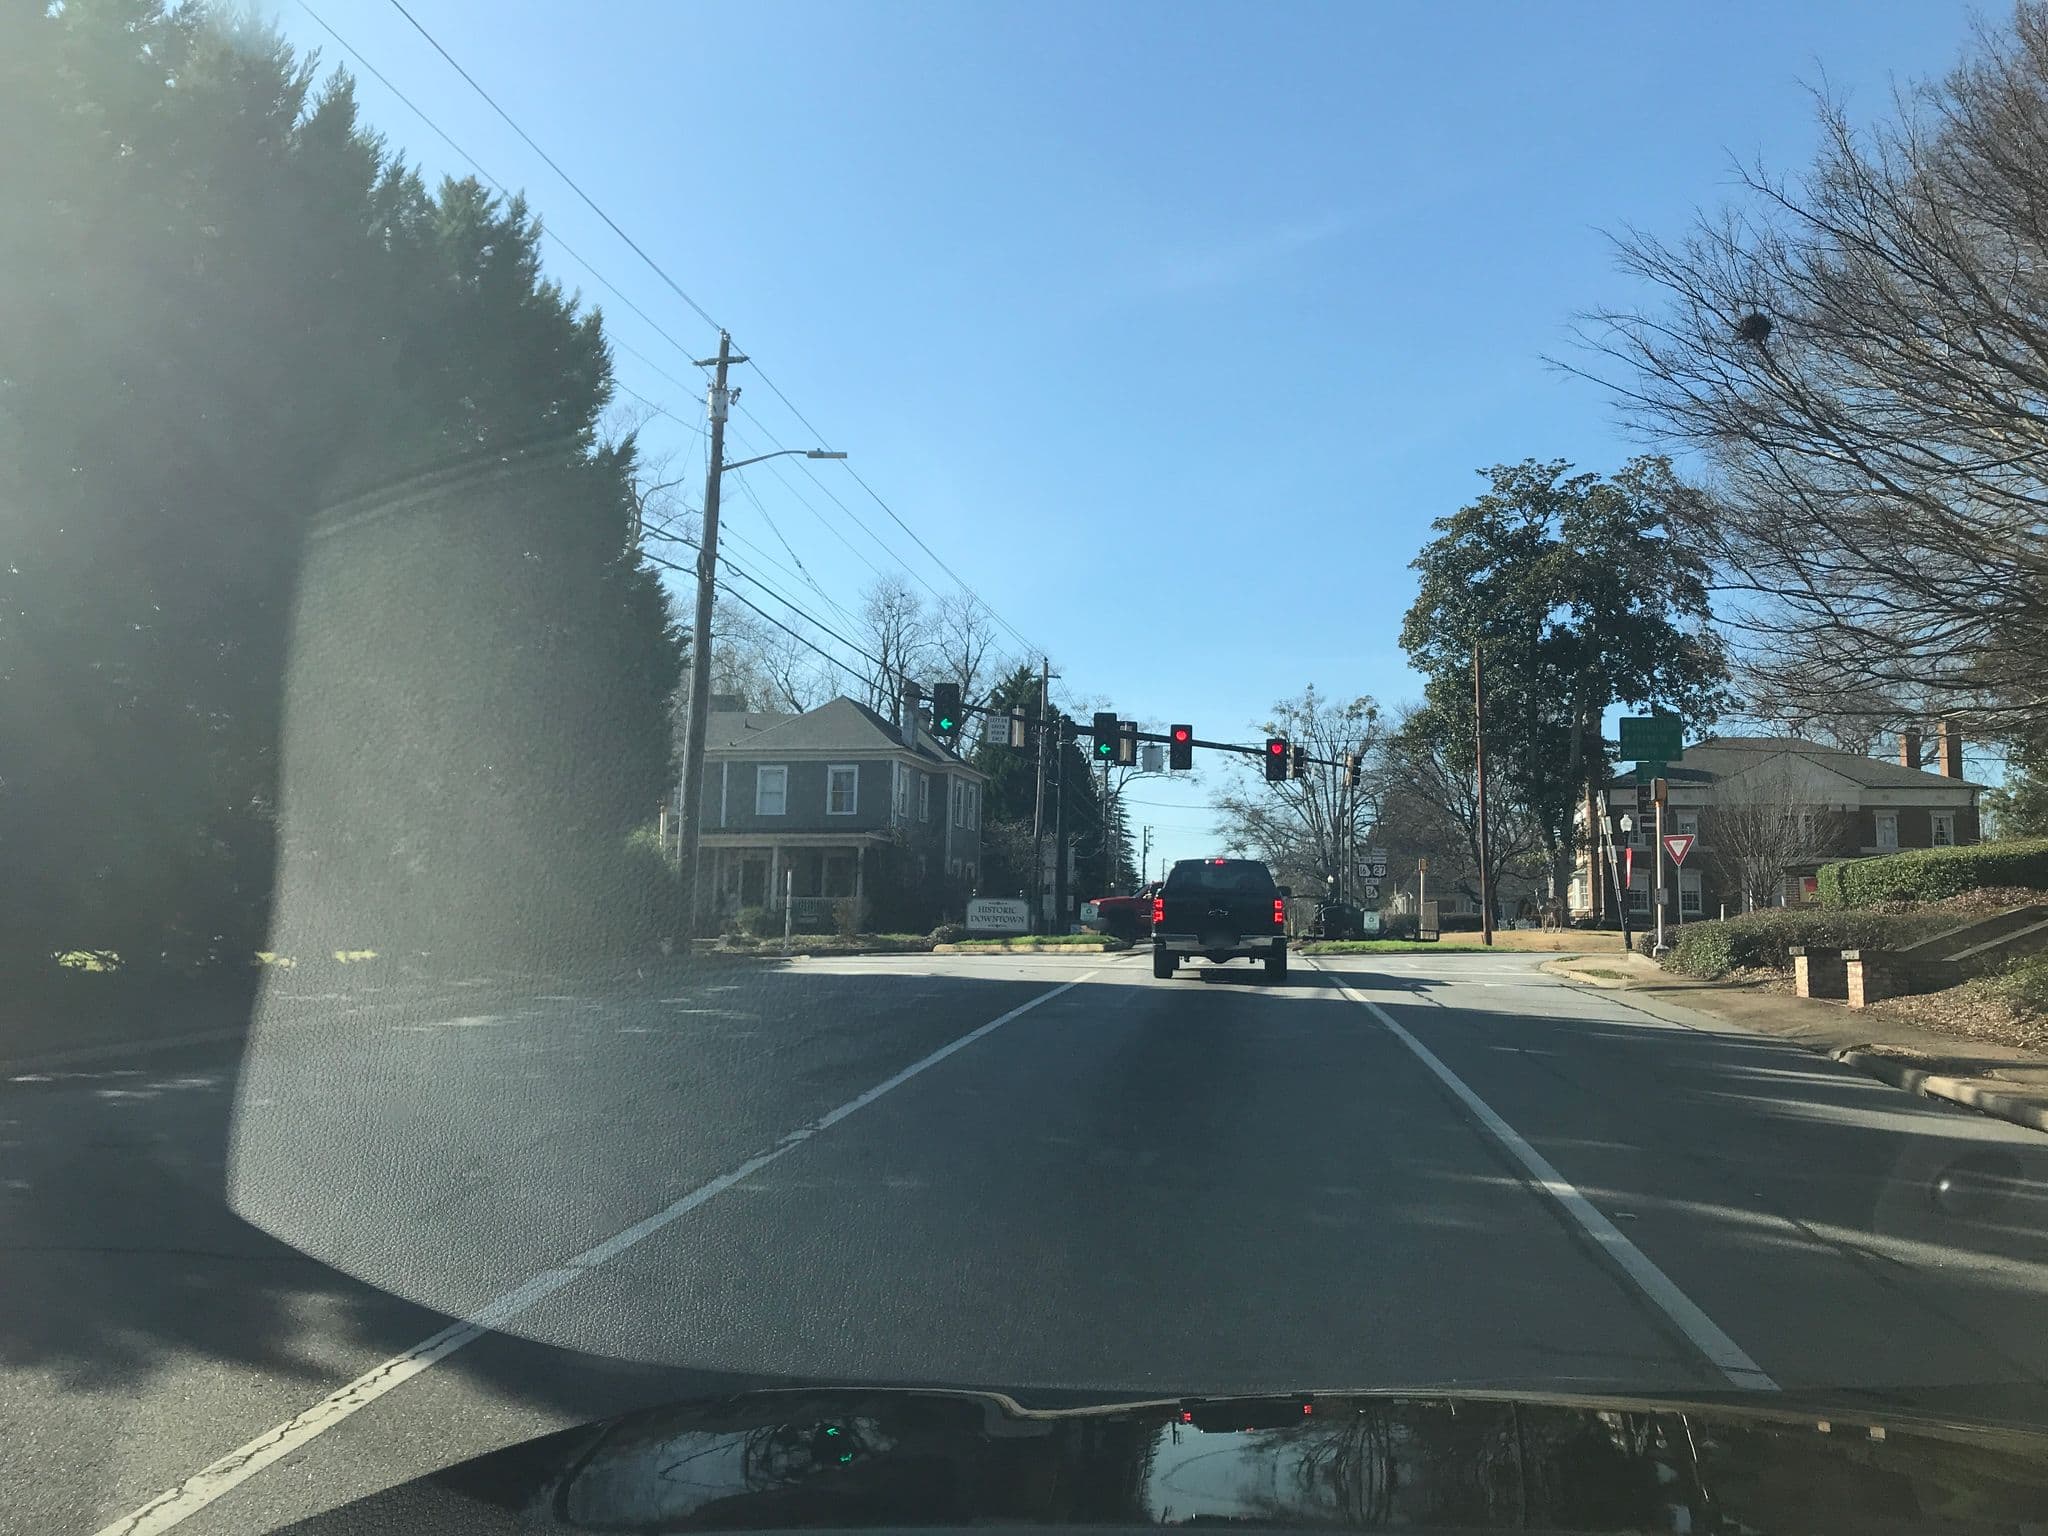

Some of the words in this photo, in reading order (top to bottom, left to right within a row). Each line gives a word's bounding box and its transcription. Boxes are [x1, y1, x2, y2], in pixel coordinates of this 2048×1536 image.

[1374, 866, 1385, 875] 27
[978, 905, 1016, 914] HISTORIC
[970, 914, 1025, 923] DOWNTOWN
